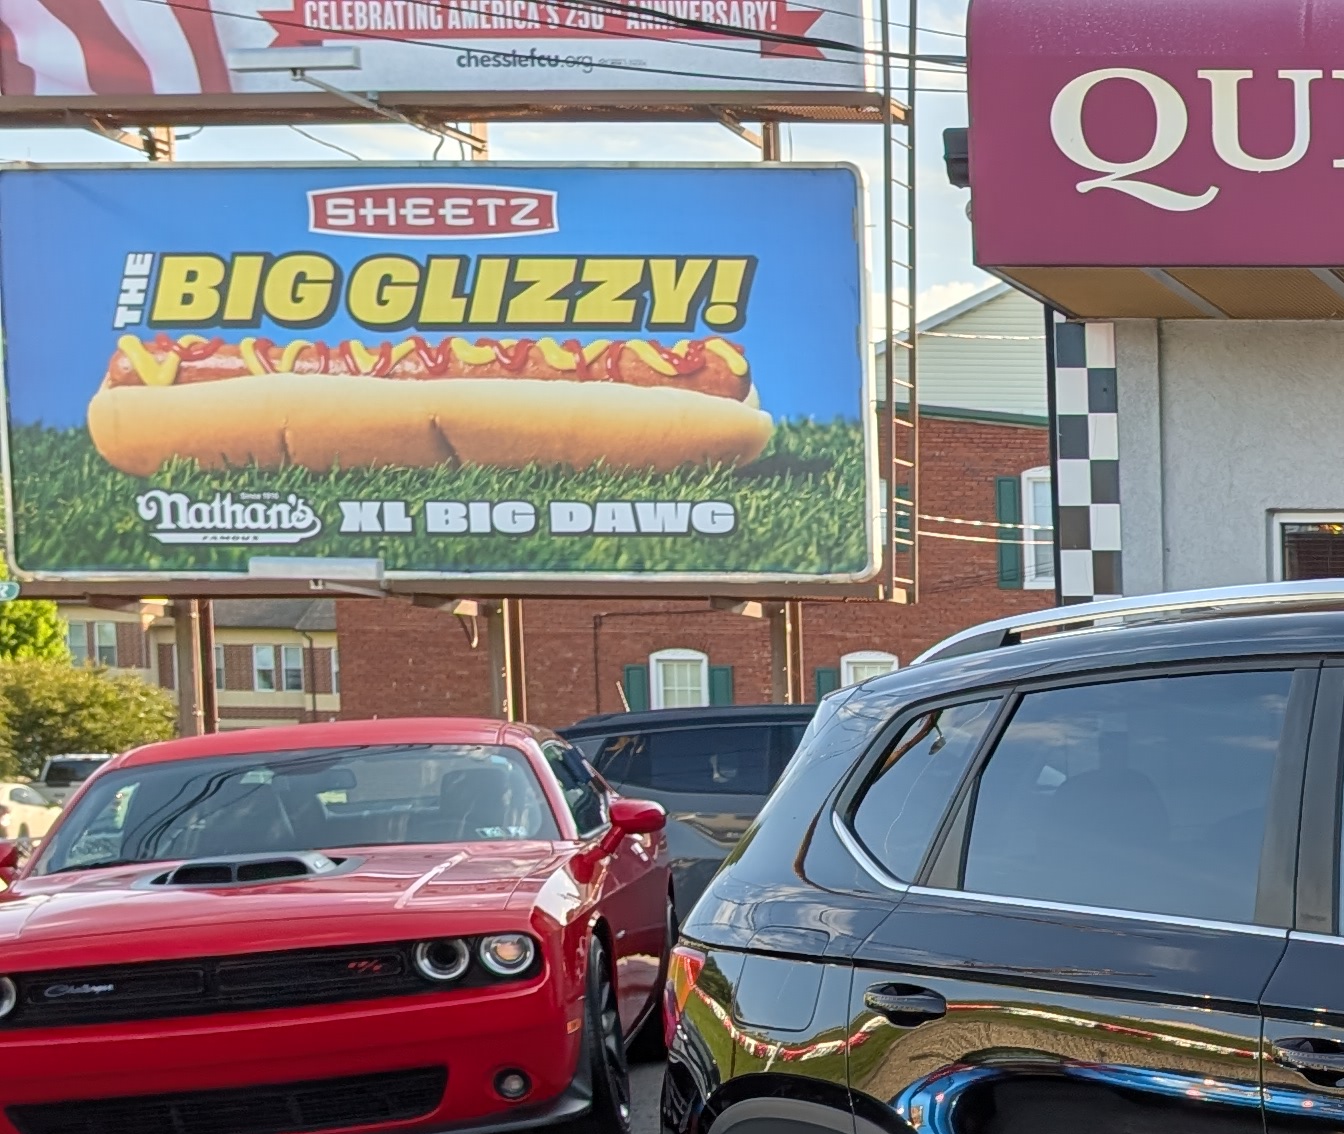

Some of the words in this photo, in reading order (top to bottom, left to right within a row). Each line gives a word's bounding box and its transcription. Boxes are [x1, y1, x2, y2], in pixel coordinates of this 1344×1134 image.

[303, 0, 443, 31] CELEBRATING
[447, 0, 560, 30] AMERICA'S
[564, 0, 623, 30] 250
[625, 0, 778, 31] ANNIVERSARY!
[323, 196, 543, 229] SHEETZ
[114, 252, 154, 330] THE
[151, 254, 337, 324] BIG
[348, 256, 752, 328] GLIZZY!
[136, 489, 320, 531] Nathan's
[339, 500, 412, 535] XL
[425, 500, 536, 535] BIG
[549, 500, 737, 535] DAWG
